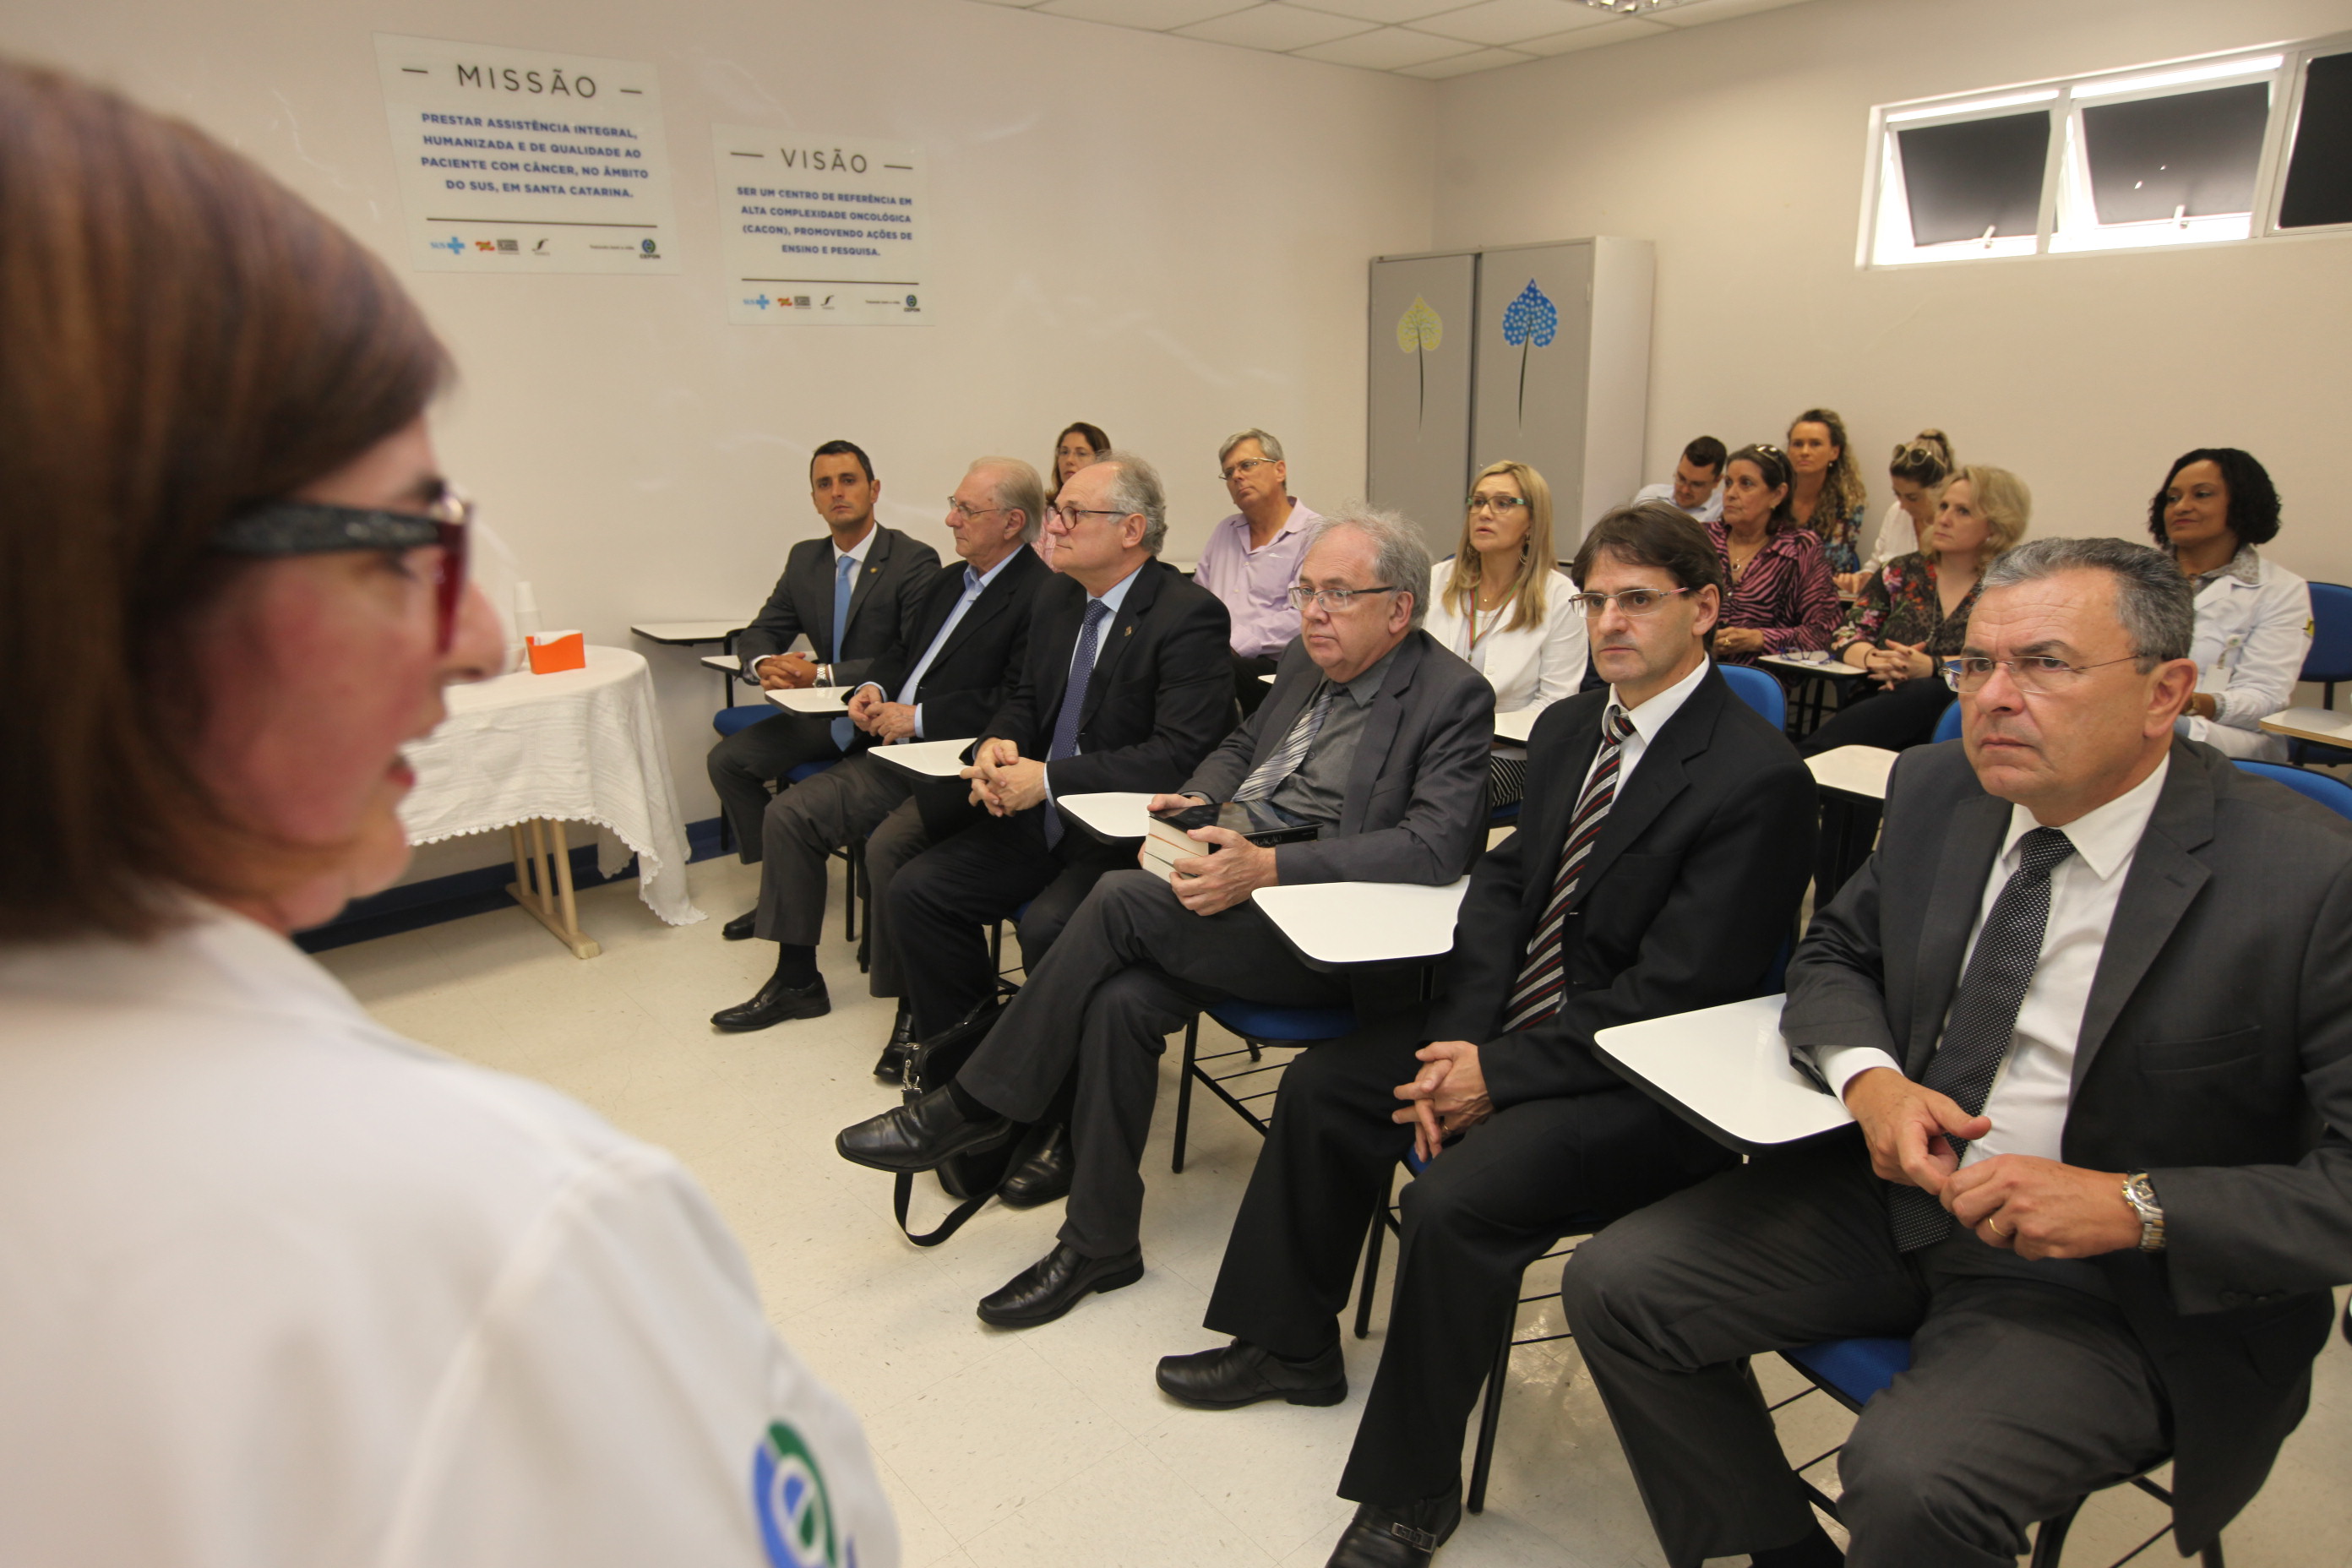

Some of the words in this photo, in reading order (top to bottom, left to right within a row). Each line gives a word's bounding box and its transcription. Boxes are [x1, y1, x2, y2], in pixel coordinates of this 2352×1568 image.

[456, 63, 596, 99] MISSÃO
[421, 112, 483, 127] PRESTAR
[487, 117, 571, 133] ASSISTÊNCIA
[573, 124, 638, 140] INTEGRAL,
[422, 134, 514, 151] HUMANIZADA
[518, 141, 526, 151] E
[529, 142, 547, 153] DE
[550, 144, 621, 158] QUALIDADE
[624, 149, 642, 159] AO
[420, 156, 487, 171] PACIENTE
[490, 161, 520, 172] COM
[523, 161, 579, 177] CÂNCER,
[581, 166, 600, 177] NO
[603, 166, 650, 179] ÂMBITO
[781, 148, 868, 174] VISÃO
[444, 179, 466, 190] DO
[468, 180, 499, 193] SUS,
[502, 182, 522, 193] EM
[524, 183, 567, 195] SANTA
[569, 185, 634, 199] CATARINA.
[736, 186, 758, 197] SER
[759, 188, 776, 198] UM
[777, 188, 819, 201] CENTRO
[821, 192, 836, 202] DE
[836, 193, 897, 205] REFERÊNCIA
[898, 197, 913, 206] EM
[740, 205, 767, 216] ALTA
[769, 207, 847, 220] COMPLEXIDADE
[849, 211, 912, 224] ONCOLÓGICA
[742, 224, 792, 237] (CACON),
[793, 226, 864, 238] PROMOVENDO
[866, 229, 898, 241] AÇÕES
[899, 231, 913, 241] DE
[781, 243, 820, 254] ENSINO
[821, 245, 829, 255] E
[830, 246, 881, 257] PESQUISA.
